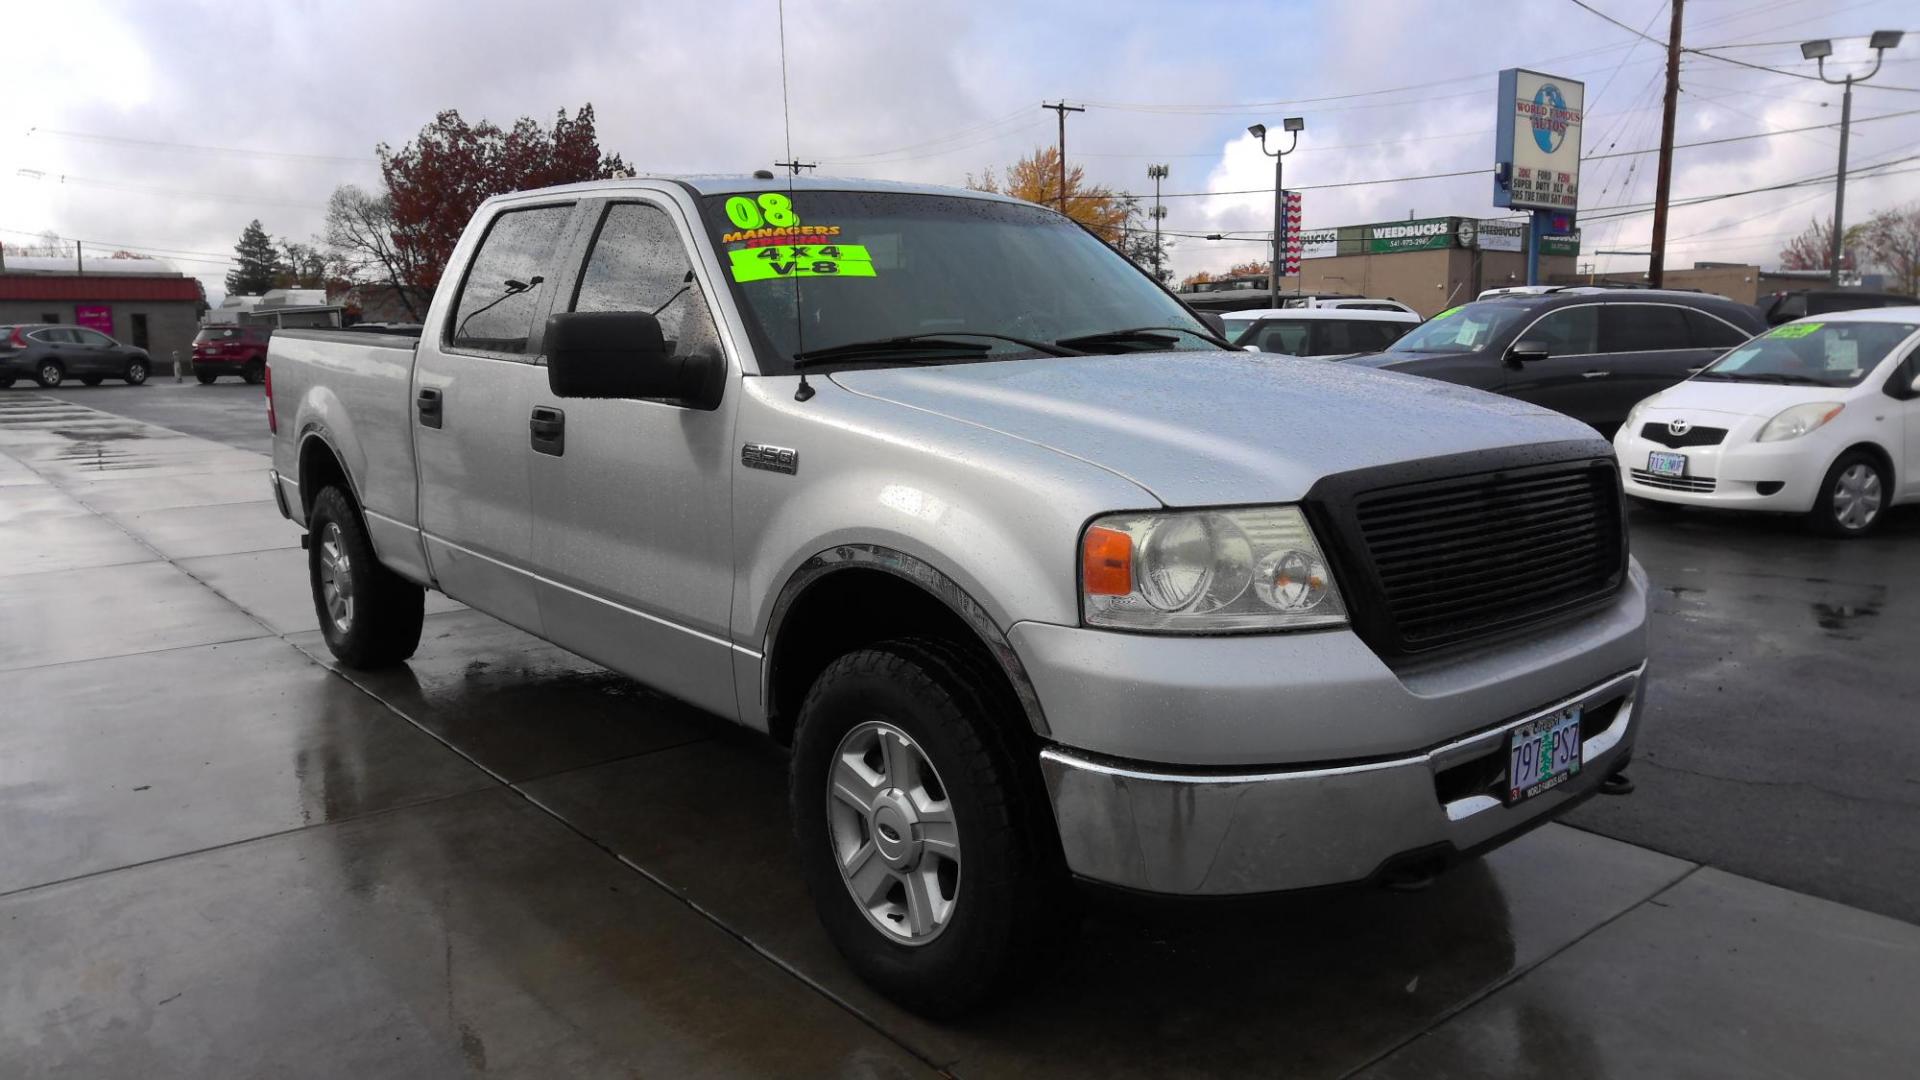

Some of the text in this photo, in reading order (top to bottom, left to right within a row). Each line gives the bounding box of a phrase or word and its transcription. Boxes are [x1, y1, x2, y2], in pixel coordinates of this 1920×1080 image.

[1517, 103, 1580, 122] WORLD FAMOUS
[1537, 169, 1551, 180] FORD
[1513, 178, 1531, 189] SUPER
[1535, 180, 1550, 191] DUTY
[1553, 182, 1564, 193] XLT
[1536, 192, 1550, 202] THRU
[1551, 193, 1561, 204] SAT
[725, 193, 799, 229] 08
[722, 226, 841, 243] MANAGERS
[1373, 222, 1448, 239] WEEDBUCKS
[1513, 738, 1542, 786] 797
[1552, 723, 1578, 769] PSZ
